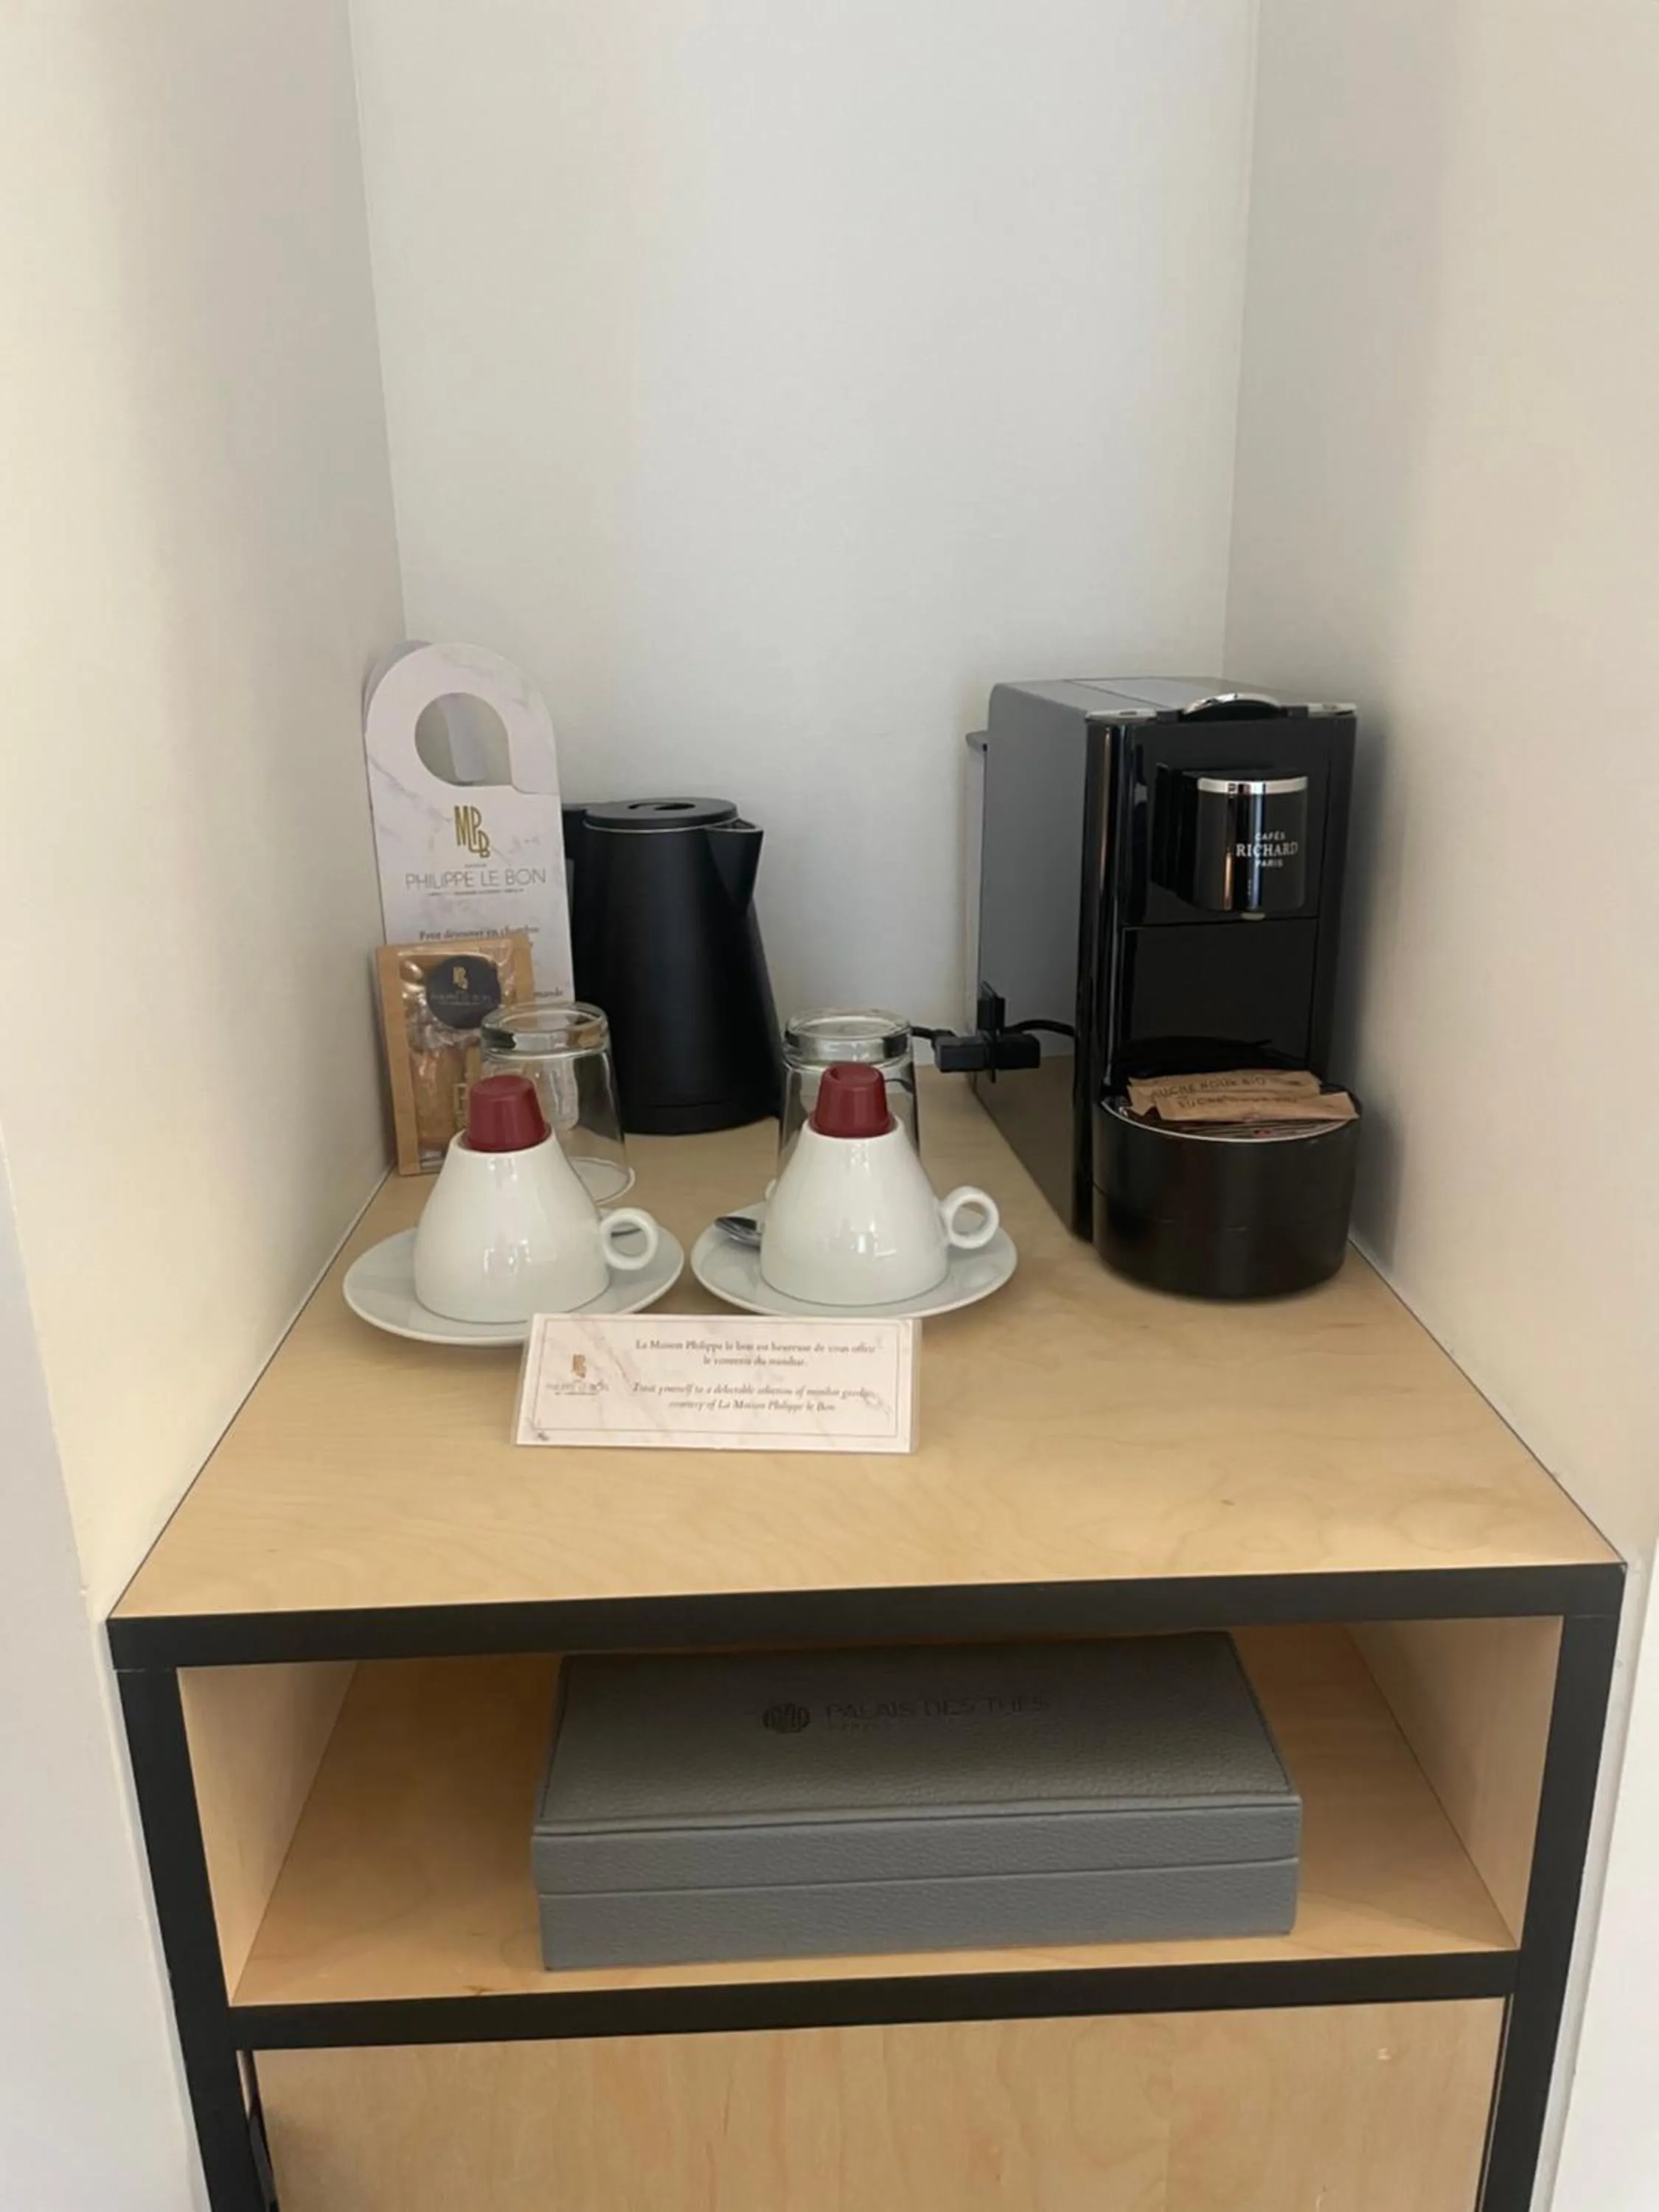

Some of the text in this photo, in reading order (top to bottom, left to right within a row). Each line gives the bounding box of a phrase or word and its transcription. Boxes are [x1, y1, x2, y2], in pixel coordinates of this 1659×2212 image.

[1236, 843, 1298, 858] RICHARD
[1255, 858, 1284, 868] PARIS
[406, 867, 546, 890] PHILIPPE LE BON
[686, 1340, 722, 1352] Philippe
[768, 1399, 803, 1413] Philippe
